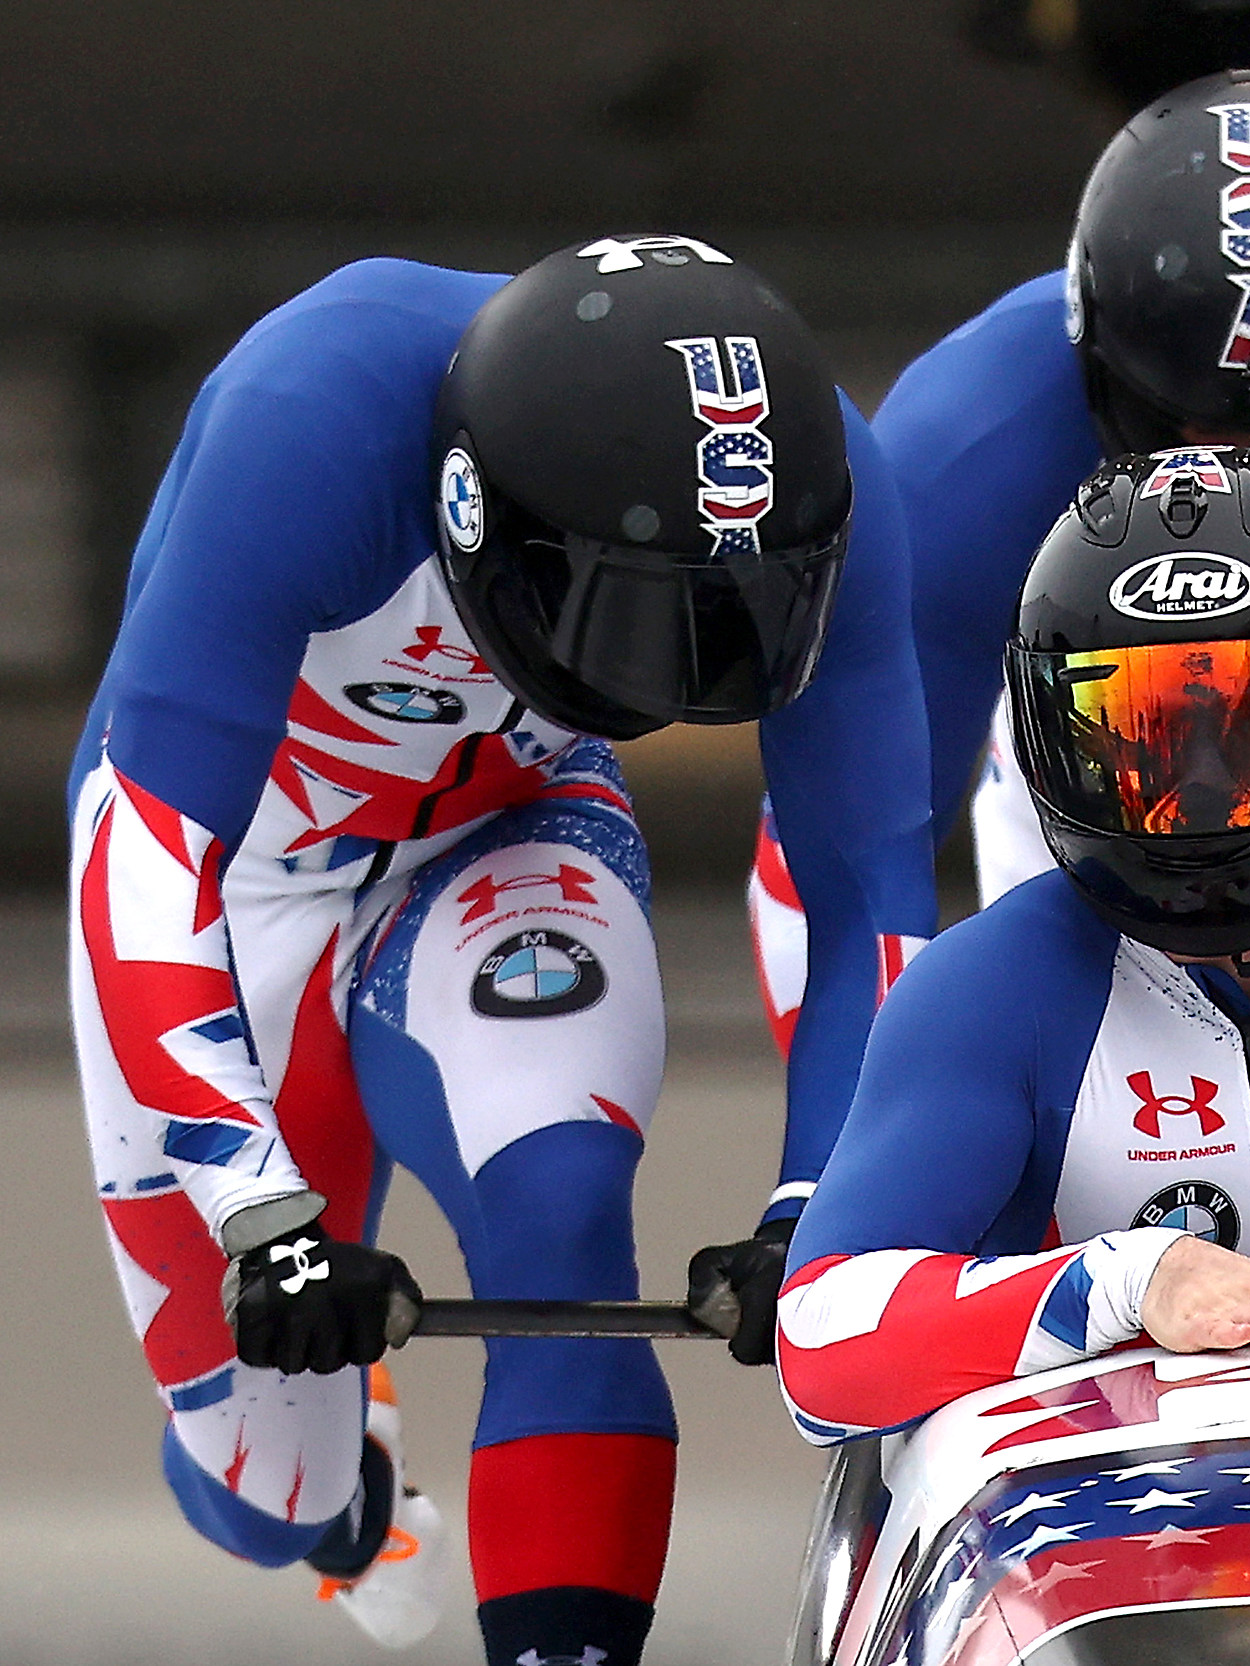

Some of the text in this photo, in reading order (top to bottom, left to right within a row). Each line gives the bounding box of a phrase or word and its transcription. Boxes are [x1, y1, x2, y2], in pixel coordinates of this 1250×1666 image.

[1121, 560, 1245, 606] Arai
[479, 932, 593, 975] BMW
[1128, 1143, 1236, 1161] UNDER ARMOUR
[1142, 1186, 1229, 1225] BMW
